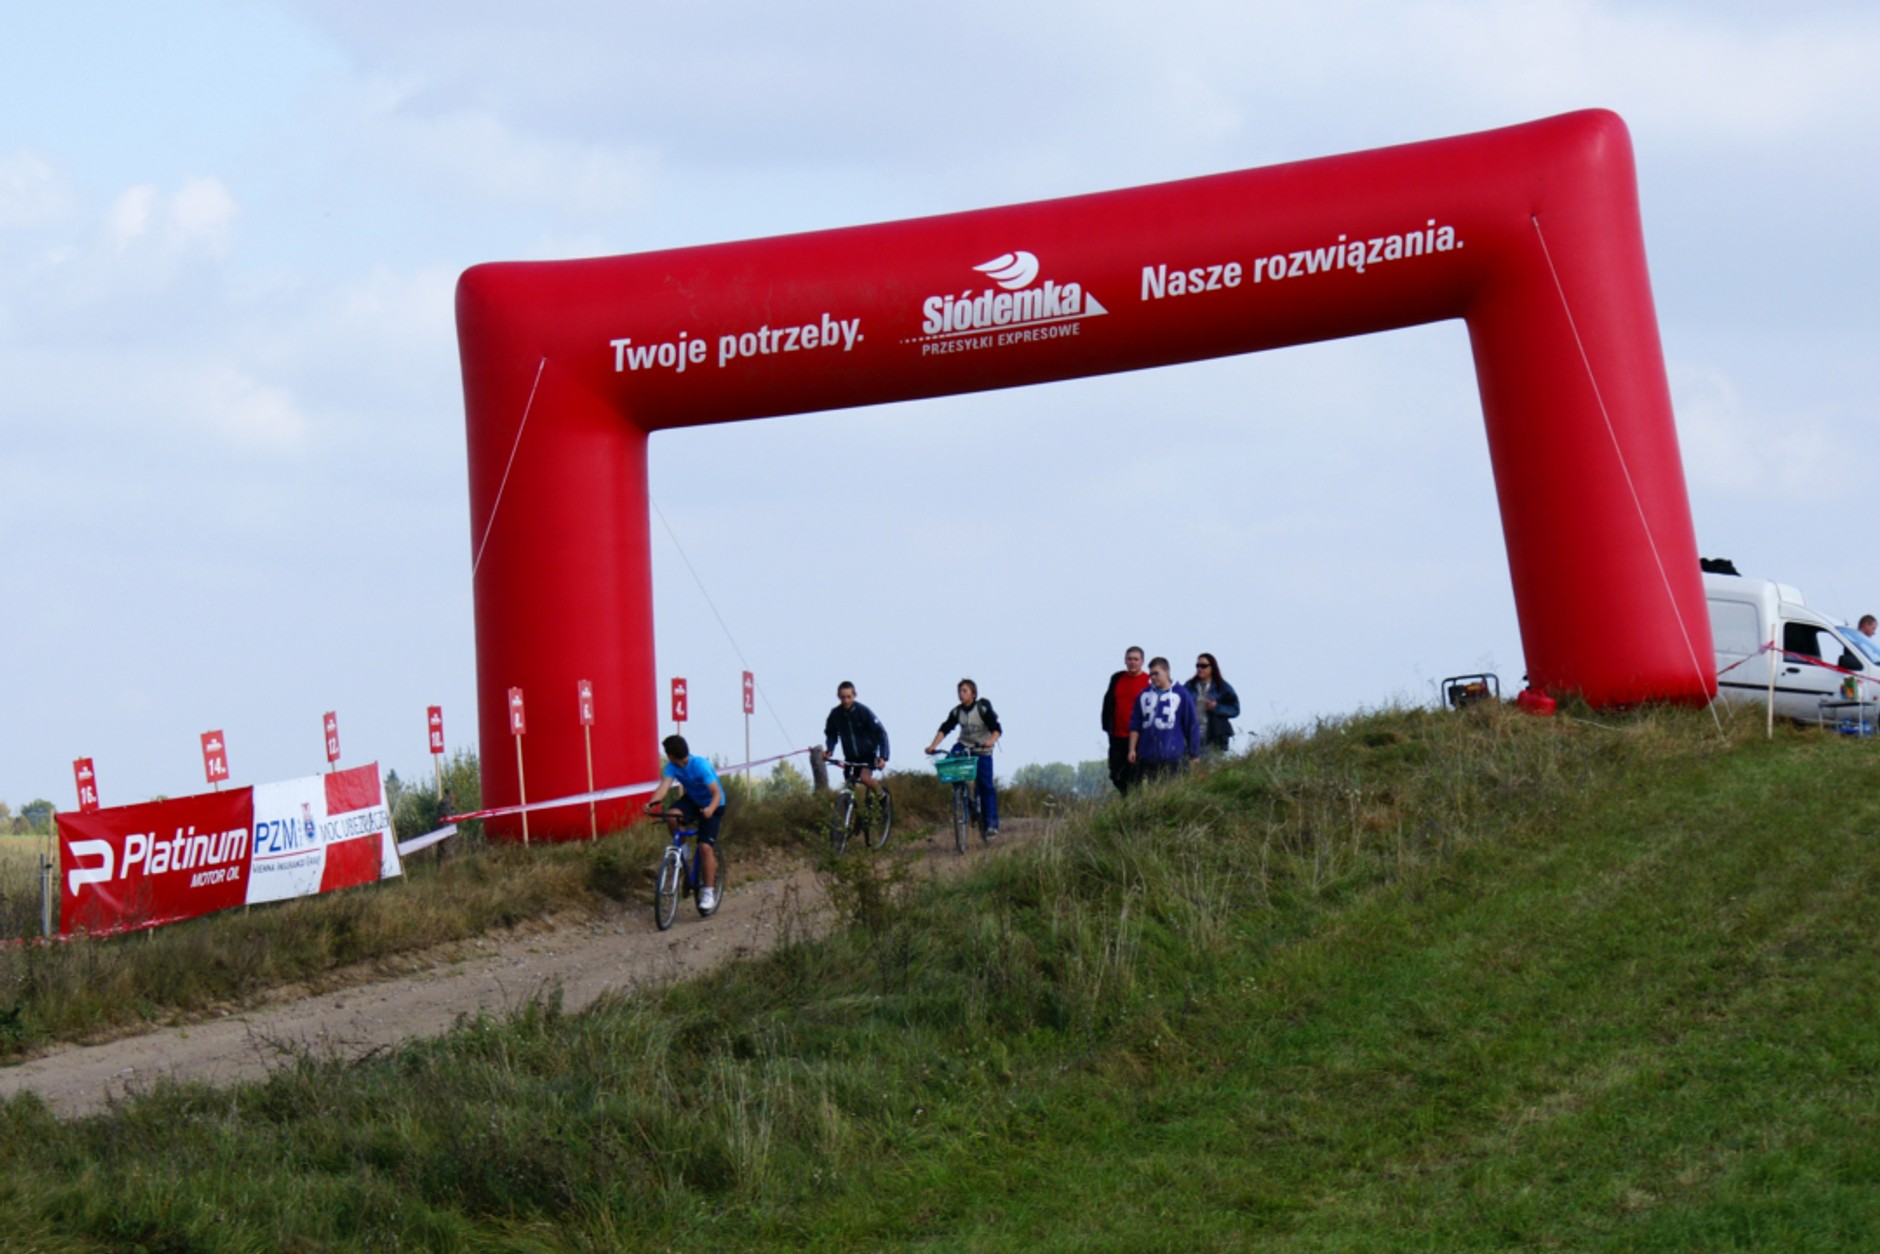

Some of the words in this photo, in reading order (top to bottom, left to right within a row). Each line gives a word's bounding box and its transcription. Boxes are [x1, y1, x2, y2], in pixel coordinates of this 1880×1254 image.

[1141, 263, 1242, 301] Nasze
[1253, 219, 1464, 284] rozwiązania.
[922, 279, 1081, 335] Siódemka
[610, 331, 707, 373] Twoje
[718, 313, 864, 368] potrzeby.
[922, 334, 993, 357] PRZESYŁKI
[997, 322, 1071, 347] EXPRESOWE
[1140, 691, 1181, 730] 93
[119, 825, 249, 880] Platinum
[254, 817, 299, 854] PZM
[190, 868, 227, 889] MOTOR
[227, 865, 241, 882] OIL
